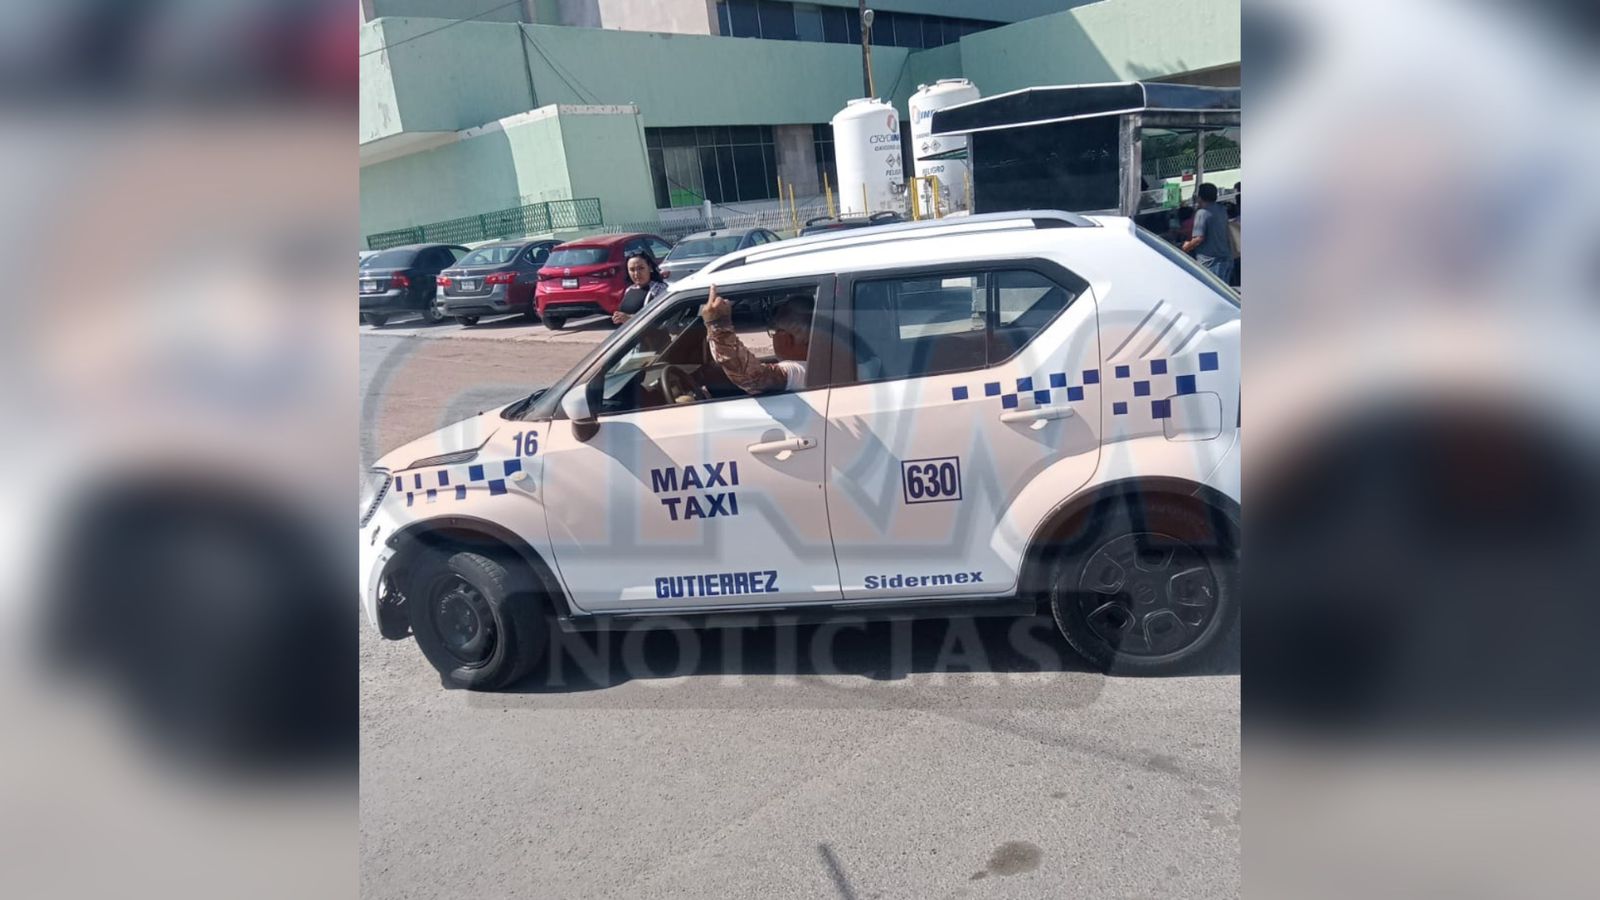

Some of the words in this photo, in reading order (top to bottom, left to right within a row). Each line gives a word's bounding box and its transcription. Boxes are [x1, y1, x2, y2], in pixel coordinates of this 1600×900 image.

[512, 430, 539, 457] 16
[651, 460, 740, 493] MAXI
[907, 462, 957, 499] 630
[661, 491, 739, 521] TAXI
[655, 570, 779, 599] GUTIERREZ
[864, 571, 984, 589] Sidermex
